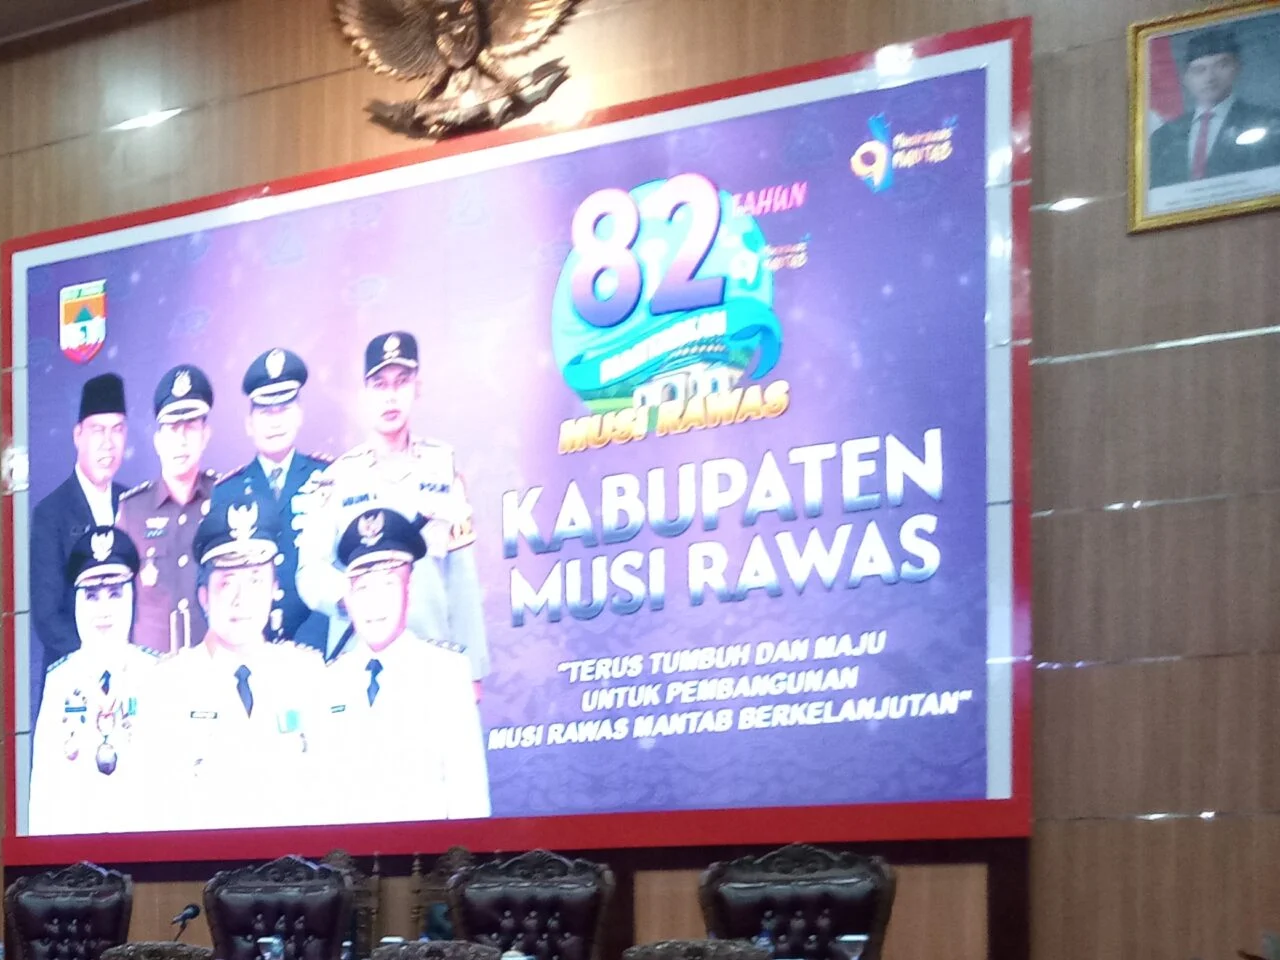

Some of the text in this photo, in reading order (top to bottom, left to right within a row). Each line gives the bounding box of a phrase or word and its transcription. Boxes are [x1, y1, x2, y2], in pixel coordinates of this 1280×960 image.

[570, 172, 726, 328] 82
[558, 380, 791, 454] MUSI RAWAS
[502, 428, 943, 558] KABUPATEN
[509, 513, 941, 627] MUSI RAWAS
[581, 666, 859, 713] UNTUK PEMBANGUNAN
[649, 644, 750, 676] TUMBUH
[755, 638, 809, 667] DAN
[813, 630, 887, 659] MAJU
[487, 724, 542, 750] MUSI
[546, 714, 629, 746] RAWAS
[633, 706, 734, 739] MANTAB
